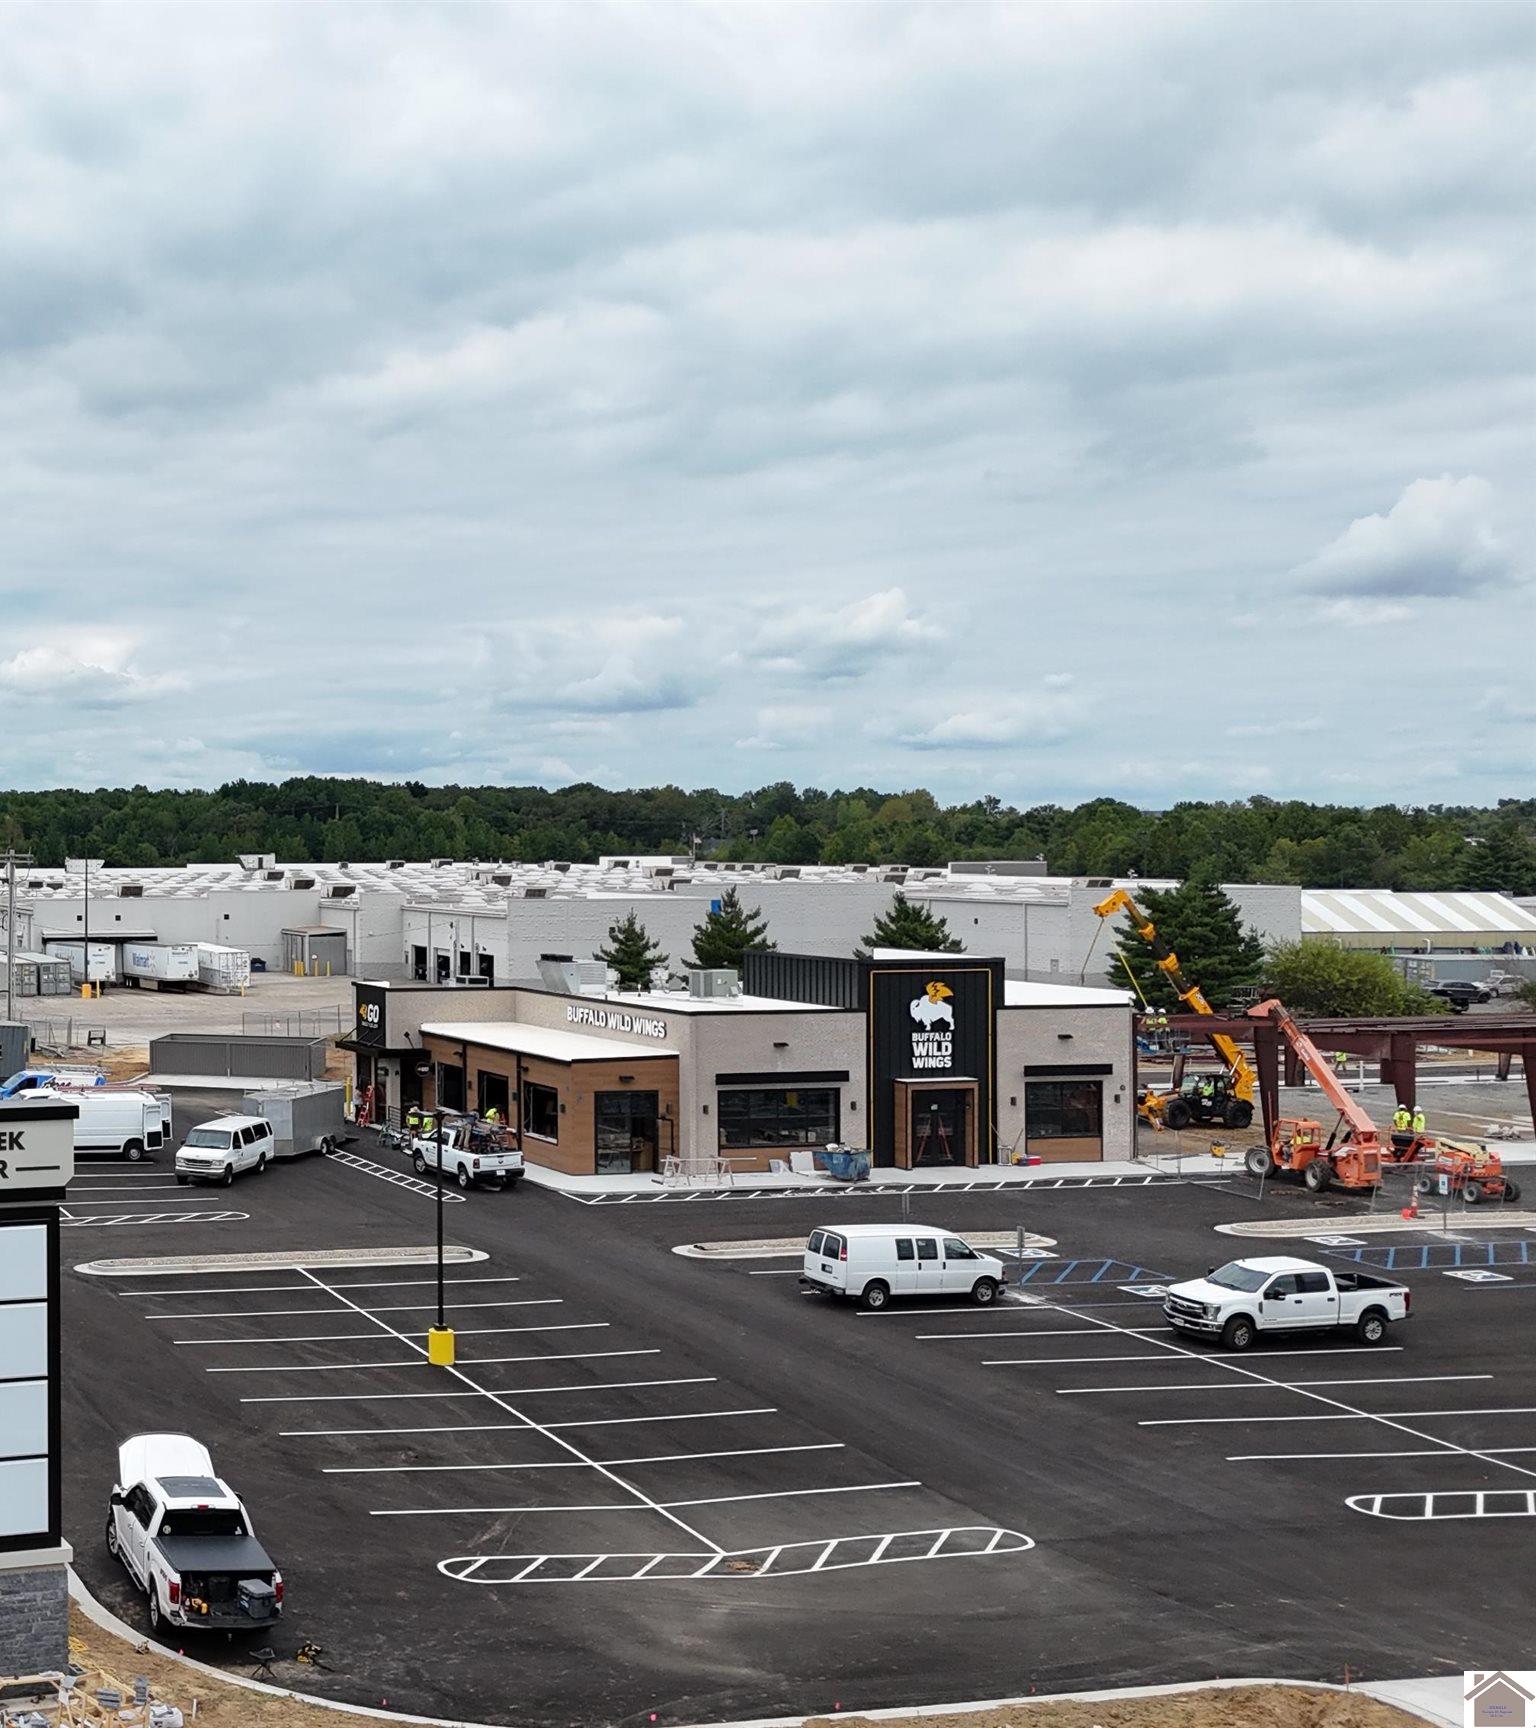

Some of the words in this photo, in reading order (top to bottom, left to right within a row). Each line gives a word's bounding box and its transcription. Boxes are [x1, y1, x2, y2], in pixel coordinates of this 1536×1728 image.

[368, 1004, 379, 1023] GO
[567, 1006, 606, 1027] BUFFALO
[607, 1012, 632, 1032] WILD
[632, 1016, 666, 1039] WINGS
[912, 1032, 952, 1041] BUFFALO
[912, 1042, 952, 1056] WILD
[912, 1057, 952, 1068] WINGS
